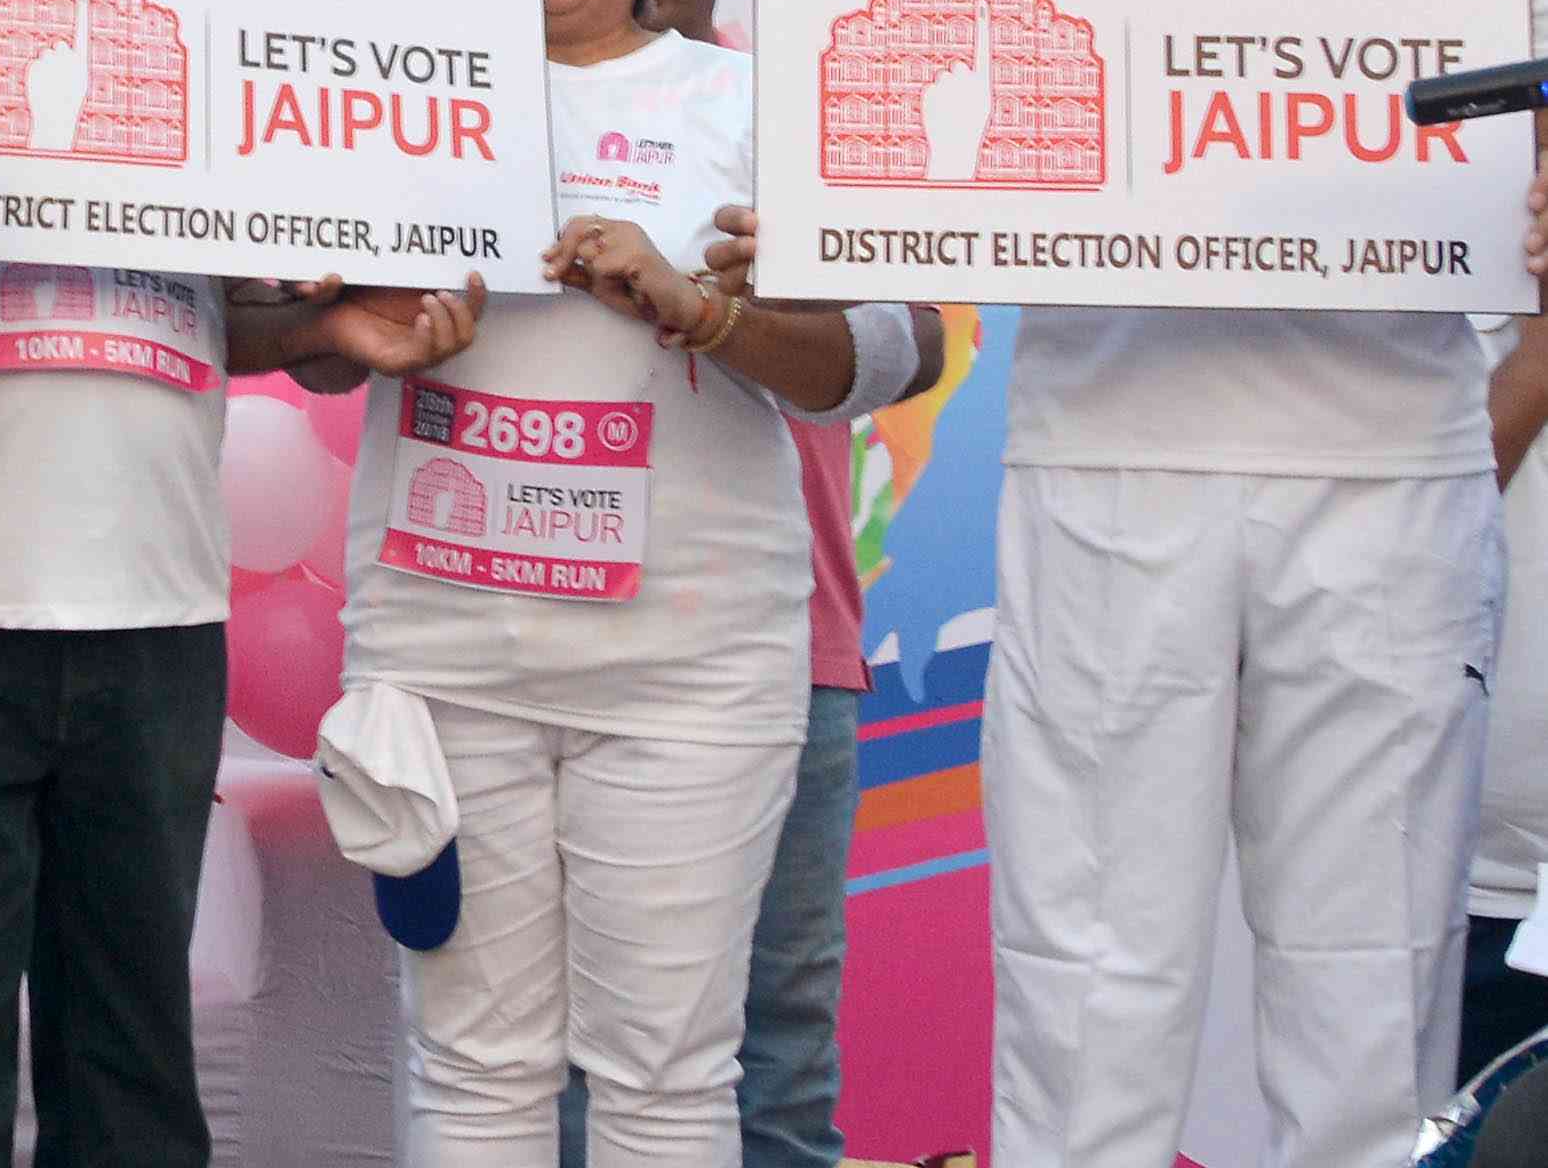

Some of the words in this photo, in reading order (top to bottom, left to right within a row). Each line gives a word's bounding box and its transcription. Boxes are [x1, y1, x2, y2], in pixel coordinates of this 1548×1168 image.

[240, 30, 356, 77] LET'S
[377, 42, 492, 89] VOTE
[1166, 35, 1303, 79] LET'S
[1320, 38, 1464, 81] VOTE
[237, 80, 495, 160] JAIPUR
[86, 201, 234, 241] ELECTION
[248, 213, 379, 256] OFFICER,
[392, 223, 501, 259] JAIPUR
[820, 228, 979, 266] DISTRICT
[993, 232, 1160, 269] ELECTION
[1176, 235, 1328, 278] OFFICER,
[1342, 239, 1471, 275] JAIPUR
[112, 287, 198, 335] JAIPUR
[15, 335, 85, 361] 10KM
[104, 340, 153, 368] 5KM
[156, 350, 192, 384] RUN
[460, 401, 586, 459] 2698
[507, 482, 562, 506] LET'S
[568, 487, 622, 510] VOTE
[501, 505, 625, 544] JAIPUR
[414, 543, 473, 576] 10KM
[490, 557, 545, 586] 5KM
[551, 563, 607, 592] RUN
